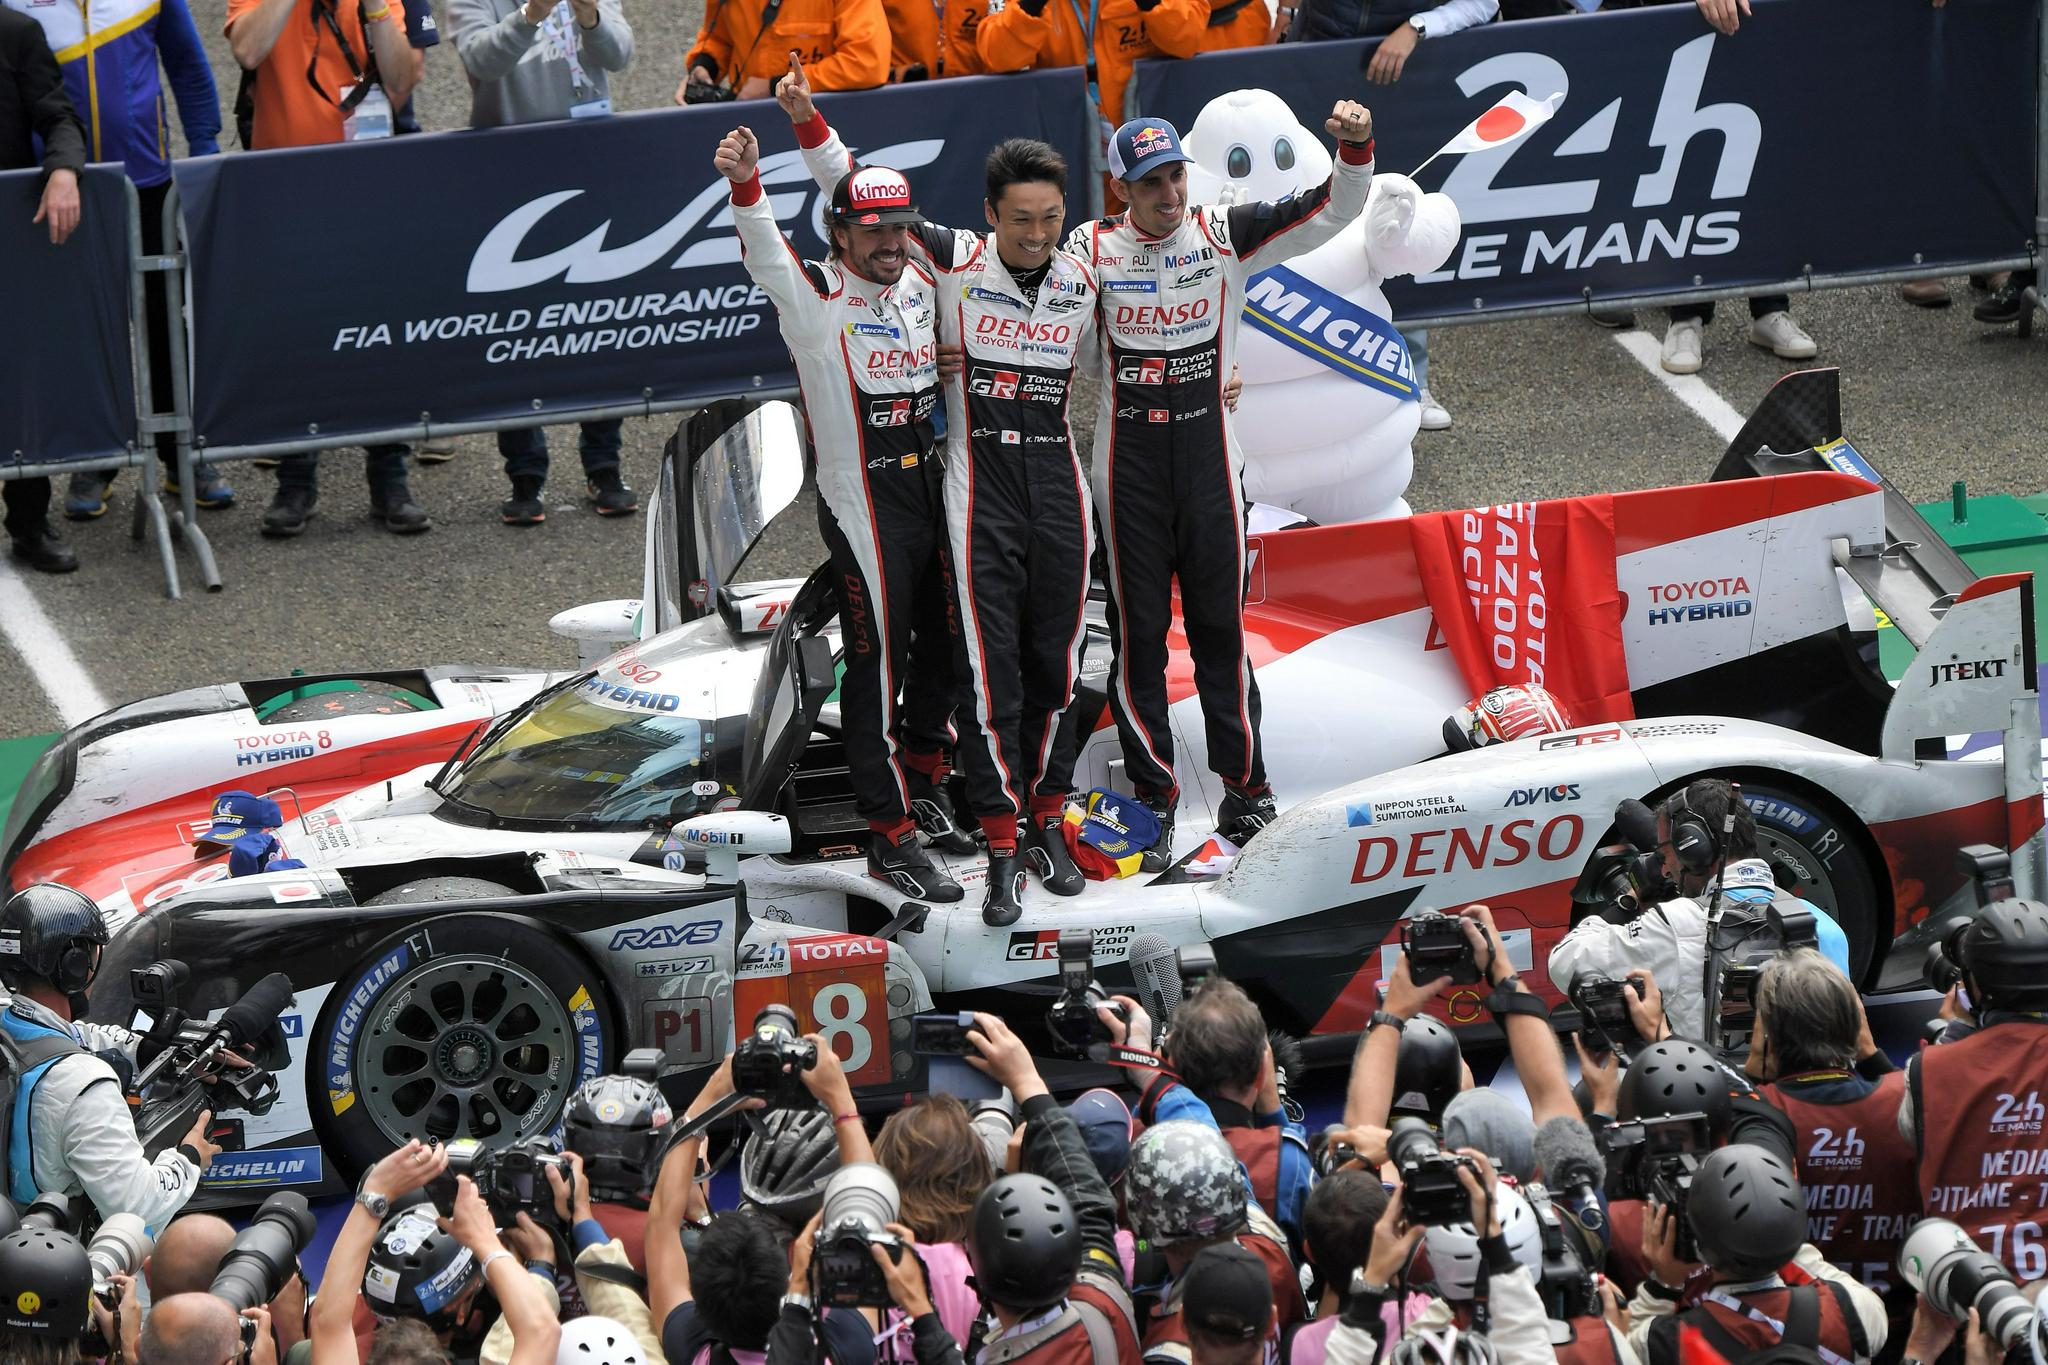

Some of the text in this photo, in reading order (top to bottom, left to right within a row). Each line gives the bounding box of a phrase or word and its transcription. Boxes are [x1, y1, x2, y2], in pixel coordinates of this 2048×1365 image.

[1438, 32, 1762, 225] 24h
[1135, 139, 1173, 158] Red Bull
[855, 183, 907, 201] kimoa
[1414, 211, 1742, 284] E MANS
[1165, 248, 1213, 269] Mobil 1
[1178, 266, 1215, 284] WEC
[1044, 276, 1086, 296] Mobil 1
[1048, 299, 1082, 310] WEC
[1116, 299, 1209, 326] DENSO
[333, 285, 767, 351] FIA WORLD ENDURANCE
[1116, 319, 1211, 336] TOYOTA HYBRID
[485, 314, 761, 363] CHAMPIONSHIP
[976, 315, 1070, 344] DENSO
[976, 336, 1068, 356] TOYOTA HYBRID
[1168, 358, 1212, 377] GAZOO
[1169, 348, 1217, 367] TOYOTA
[868, 371, 905, 379] TOYOTA
[1026, 375, 1067, 387] TOYOTA
[1119, 367, 1162, 383] GR
[1166, 368, 1212, 385] Racing
[972, 378, 1016, 398] GR
[1020, 391, 1062, 405] Racing
[1023, 383, 1064, 394] GAZOO
[870, 408, 910, 426] GR
[1647, 576, 1751, 603] TOYOTA
[844, 573, 871, 655] DENSO
[1648, 599, 1752, 626] HYBRID
[1929, 659, 2007, 688] JTEKT
[582, 678, 680, 712] HYBRID
[234, 730, 333, 750] TOYOTA 8
[1541, 730, 1620, 751] GR
[236, 744, 315, 767] HYBRID
[1375, 795, 1455, 812] NIPPON STEEL &
[1504, 783, 1581, 808] ADVICS
[1376, 804, 1468, 822] SUMITOMO METAL
[324, 826, 340, 848] GAZOO
[334, 824, 351, 848] TOYOTA
[687, 829, 743, 845] Mobil 1
[1350, 814, 1584, 885] DENSO
[1811, 828, 1845, 872] RL
[668, 855, 682, 870] N
[1772, 848, 1811, 881] RAYS
[609, 920, 723, 950] RAYS
[1094, 925, 1136, 936] YOTA
[794, 941, 883, 961] TOTAL
[1094, 936, 1129, 946] ZOO
[743, 941, 786, 964] 24h
[1008, 943, 1061, 961] GR
[1091, 946, 1126, 957] cing
[641, 958, 710, 975] 林テレンプ
[754, 962, 784, 970] MANS
[332, 955, 401, 1068] MICHELIN
[381, 991, 412, 1033] RAYS
[654, 1007, 701, 1053] P1
[812, 983, 873, 1074] 8
[1120, 1051, 1159, 1067] Canon
[520, 1088, 551, 1129] RAYS
[1991, 1091, 2046, 1124] 24h
[1989, 1123, 2005, 1133] LE
[2008, 1121, 2042, 1132] MANS
[1808, 1126, 1866, 1157] 24h
[204, 1160, 306, 1178] ICHELIN
[1807, 1157, 1863, 1167] LE MANS
[1981, 1149, 2048, 1179] MEDIA
[1802, 1184, 1874, 1210] MEDIA
[1979, 1220, 2047, 1280] 76
